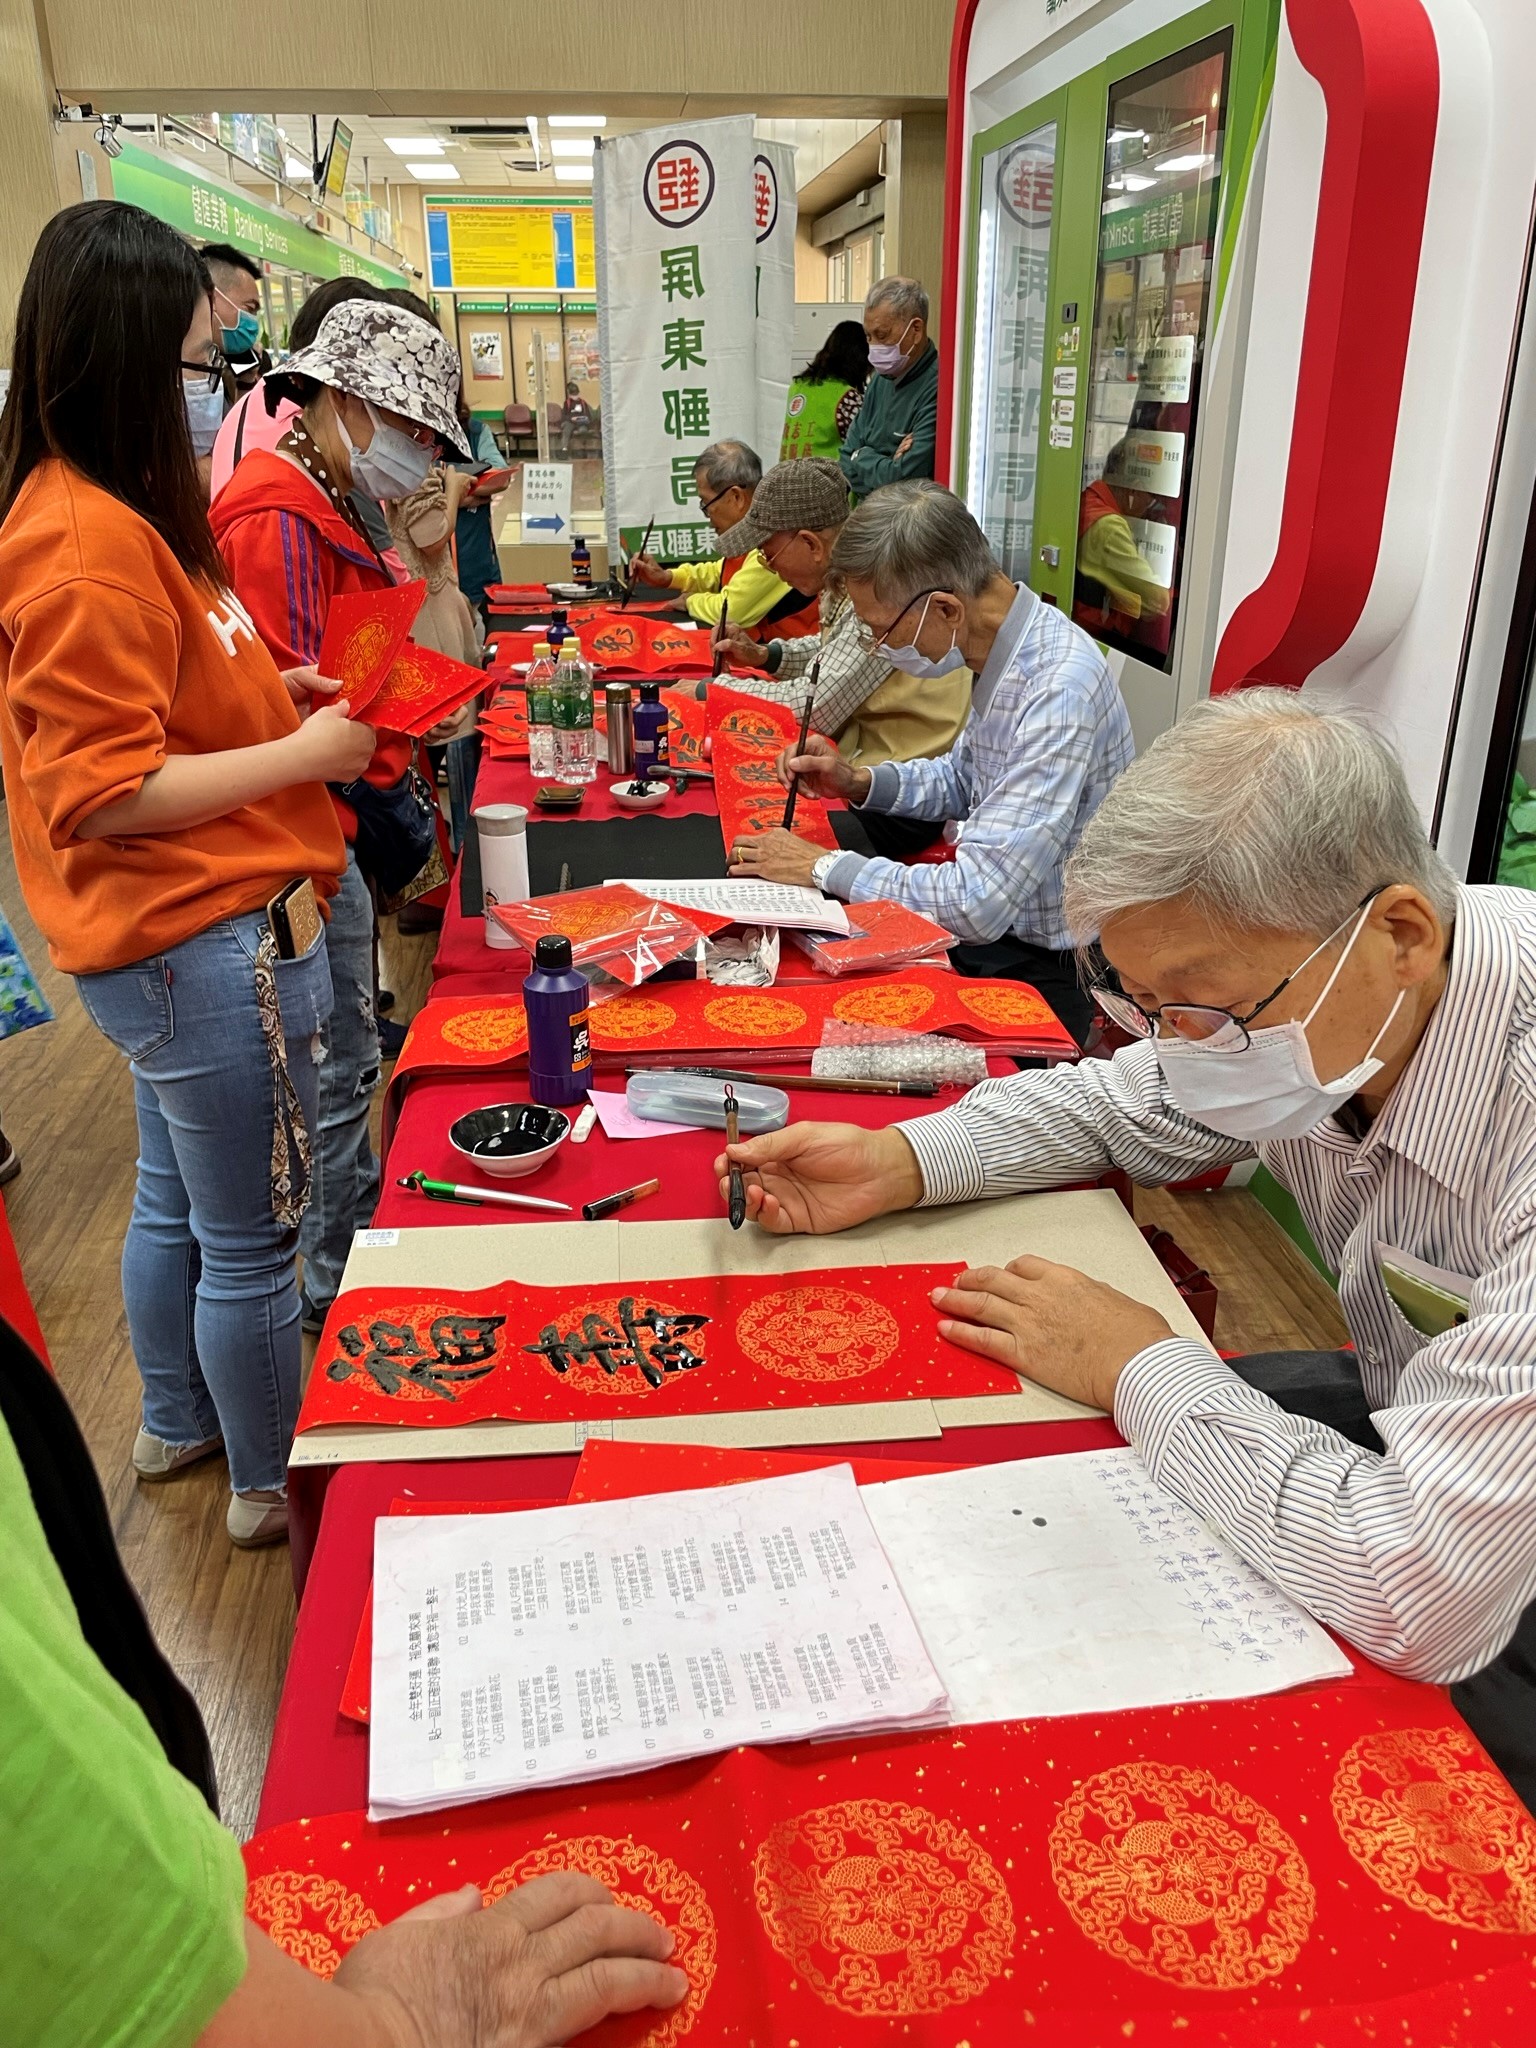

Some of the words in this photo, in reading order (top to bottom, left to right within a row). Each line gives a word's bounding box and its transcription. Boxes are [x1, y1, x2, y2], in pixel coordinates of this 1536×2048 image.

[191, 184, 229, 236] 儲匯業務
[234, 206, 264, 252] Banking
[264, 223, 288, 255] Services
[527, 469, 556, 478] 書寫春聯
[527, 481, 563, 490] 請由此方向
[872, 1699, 883, 1709] 15
[816, 1711, 827, 1720] 13
[760, 1720, 772, 1729] 11
[703, 1728, 715, 1739] 09
[645, 1739, 656, 1749] 07
[585, 1748, 597, 1759] 05
[526, 1759, 536, 1769] 03
